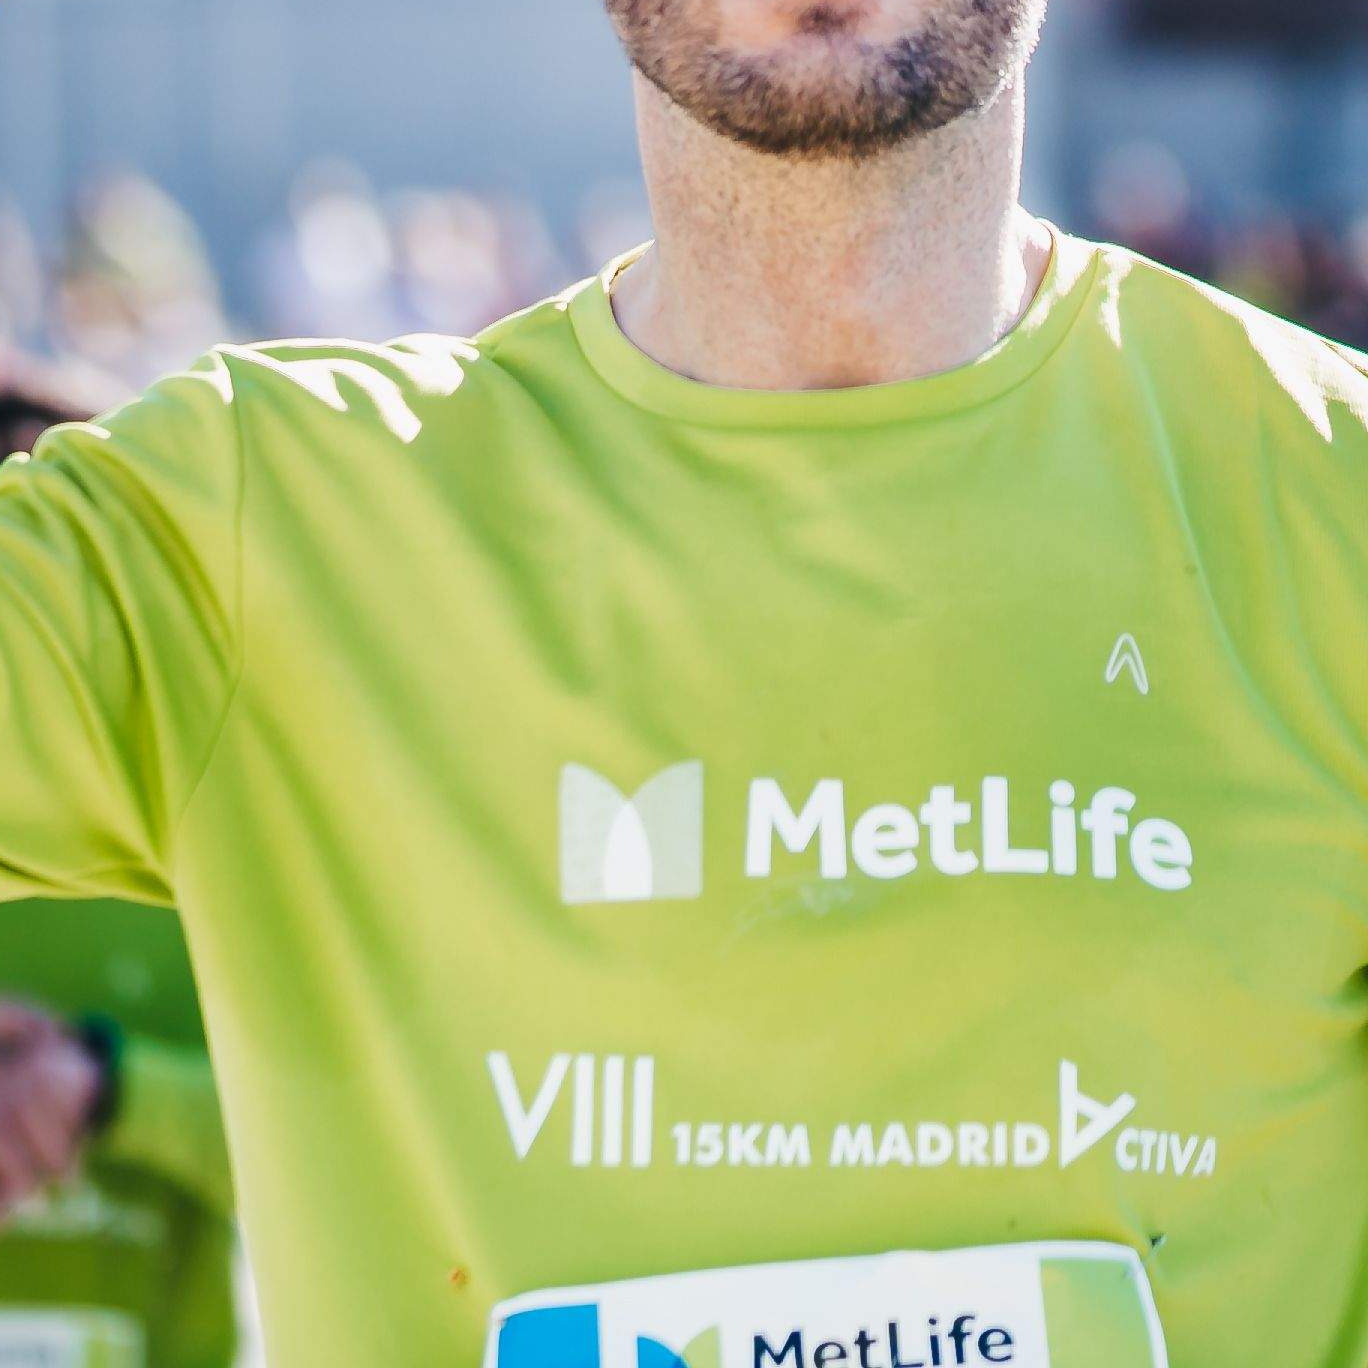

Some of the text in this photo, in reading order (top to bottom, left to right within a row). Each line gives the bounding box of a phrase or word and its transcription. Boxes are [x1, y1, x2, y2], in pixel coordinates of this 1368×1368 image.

[742, 774, 1194, 892] MetLife
[484, 1049, 656, 1170] VIII
[669, 1121, 813, 1169] 15KM
[827, 1120, 1052, 1169] MADRID
[751, 1313, 1015, 1368] MetLife
